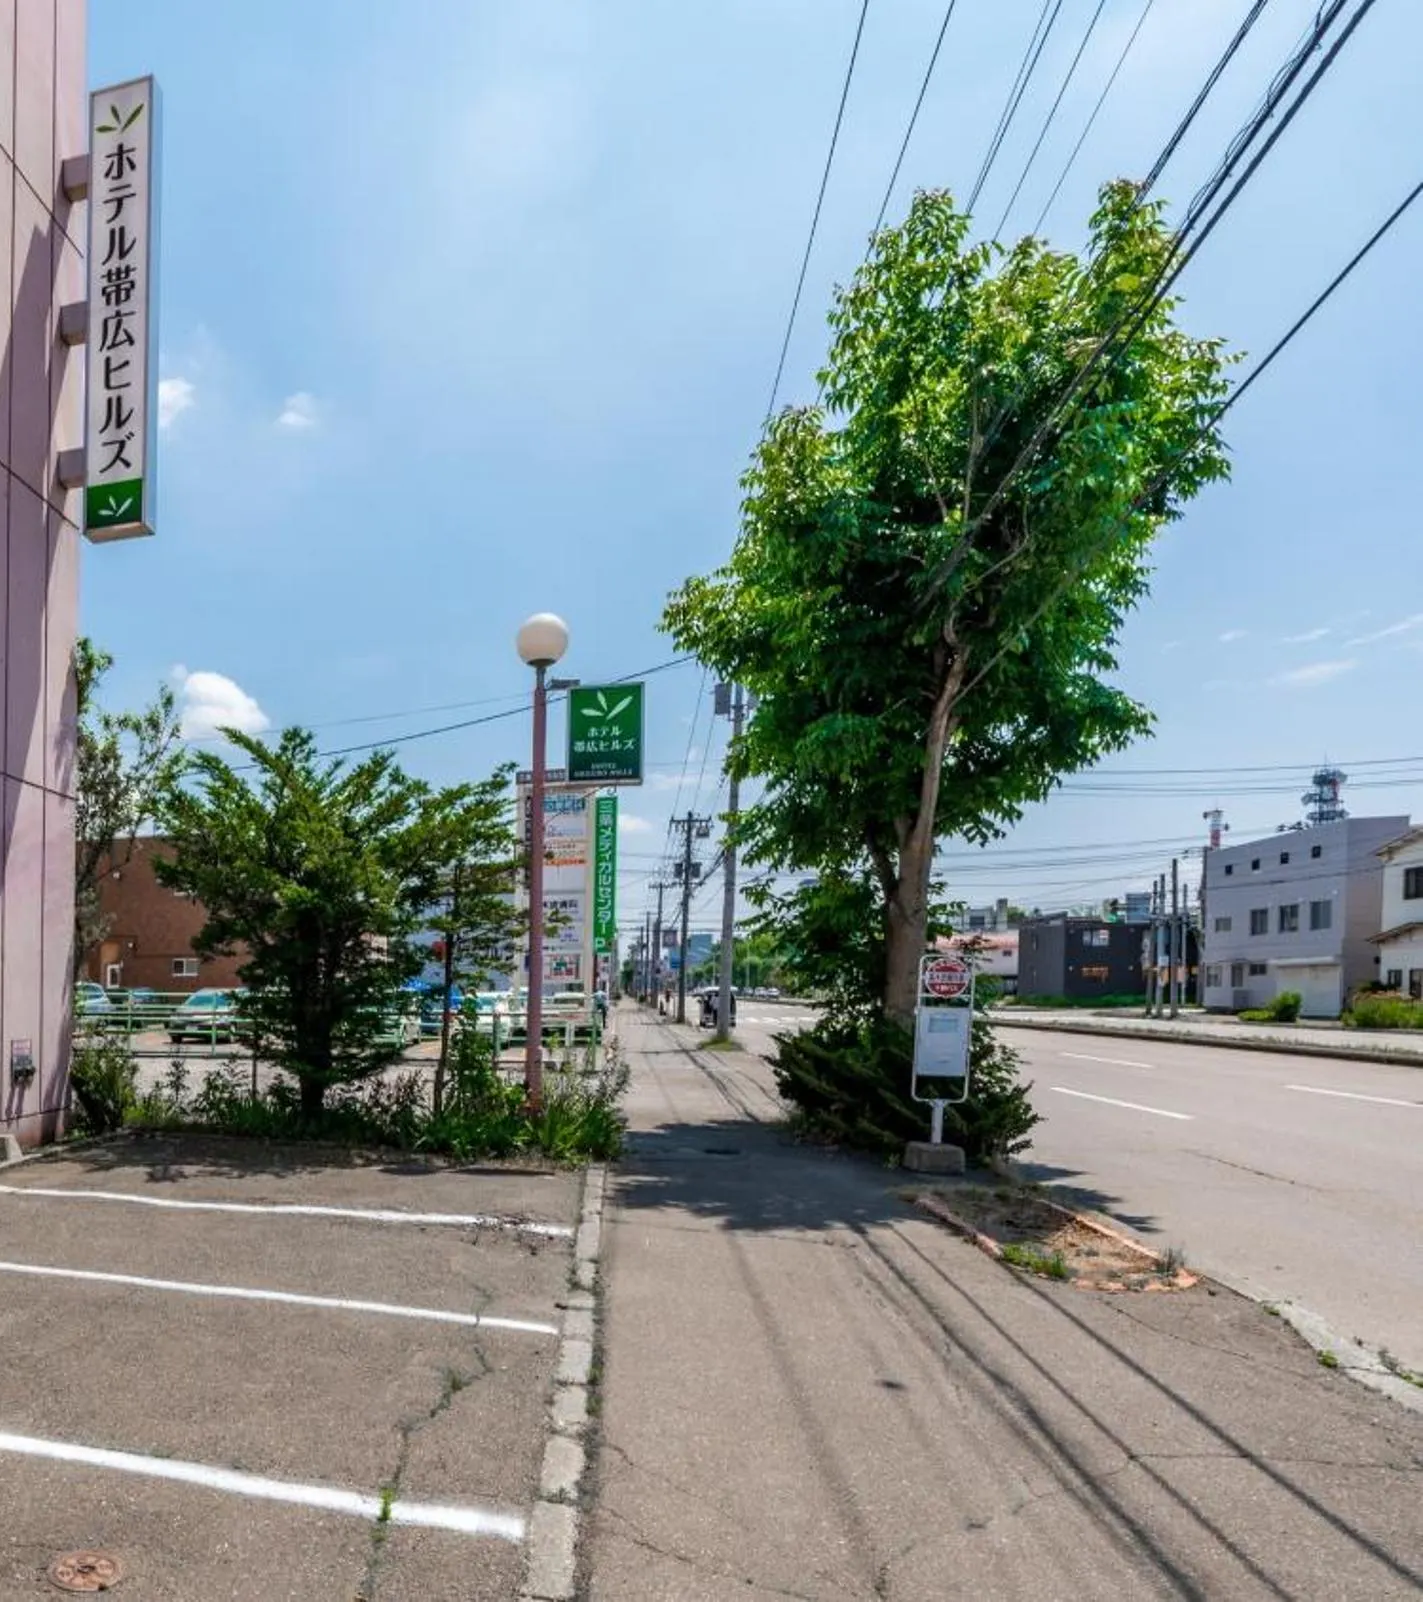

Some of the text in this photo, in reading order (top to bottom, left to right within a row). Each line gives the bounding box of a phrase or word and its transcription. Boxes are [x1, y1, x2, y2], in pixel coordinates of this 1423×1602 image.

[99, 143, 137, 473] ホテル帯広ヒルズ
[587, 725, 623, 738] ホテル
